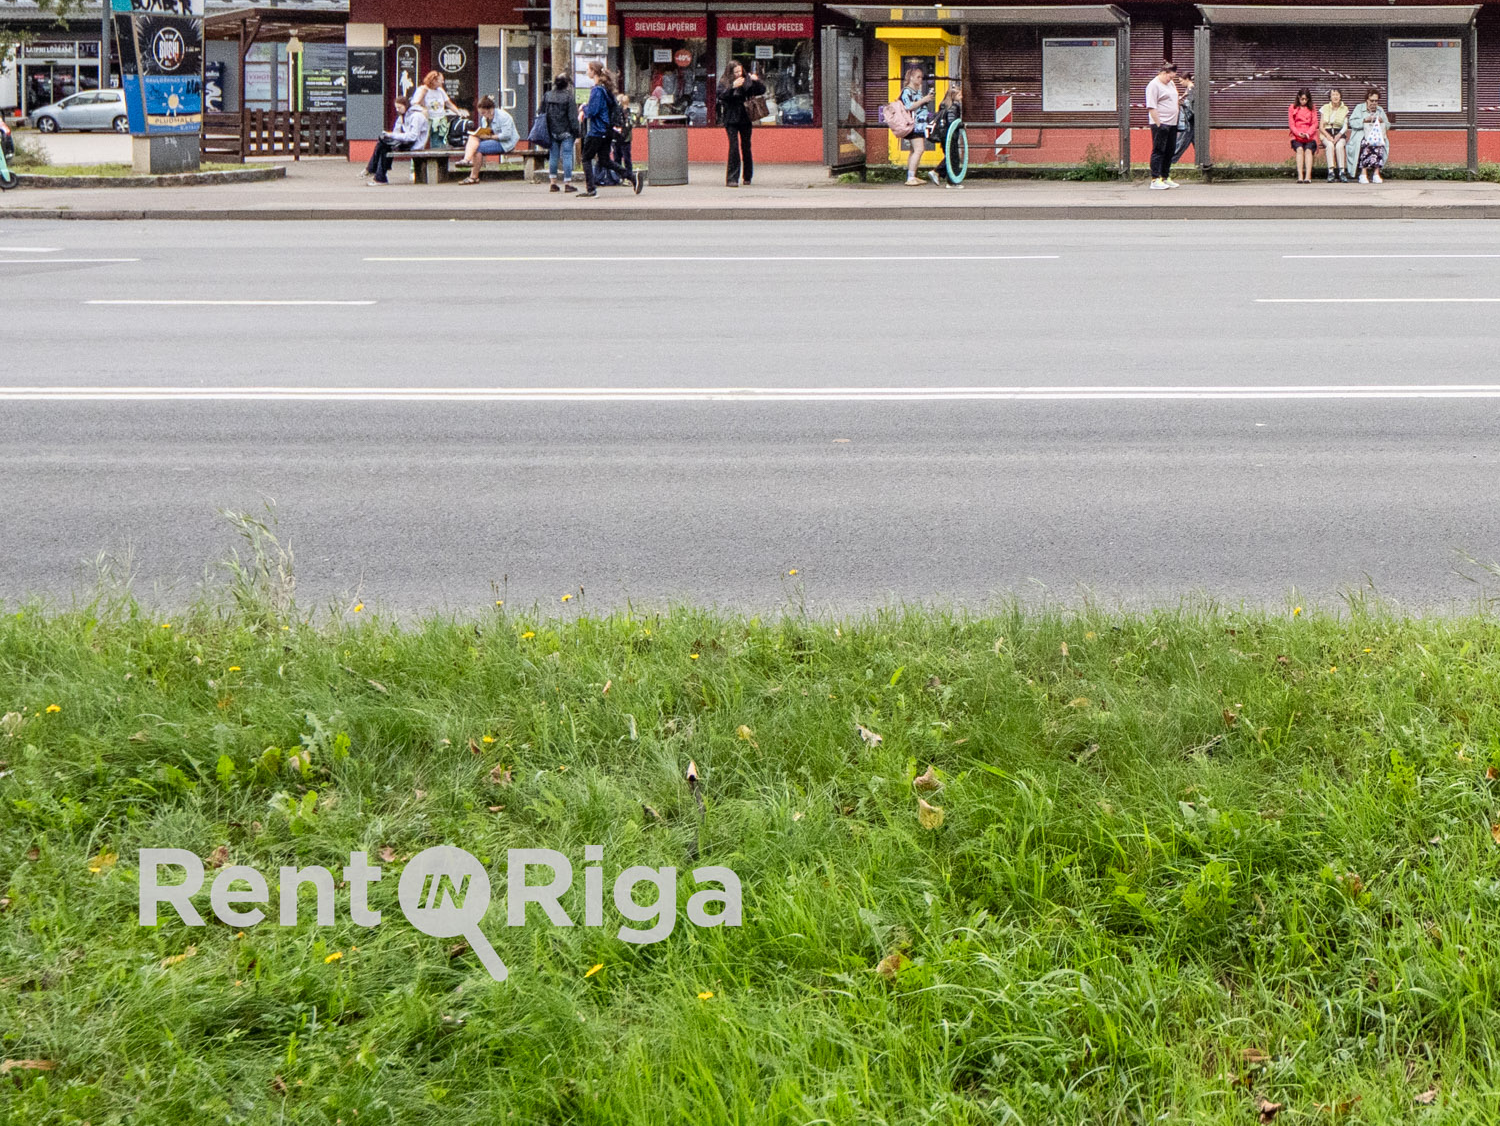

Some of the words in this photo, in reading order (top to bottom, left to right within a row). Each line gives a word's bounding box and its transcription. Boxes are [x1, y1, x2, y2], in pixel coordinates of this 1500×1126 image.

[635, 21, 665, 31] SIEVIEŠU
[726, 21, 776, 32] GALANTĒRIJAS
[778, 23, 804, 32] PRECES
